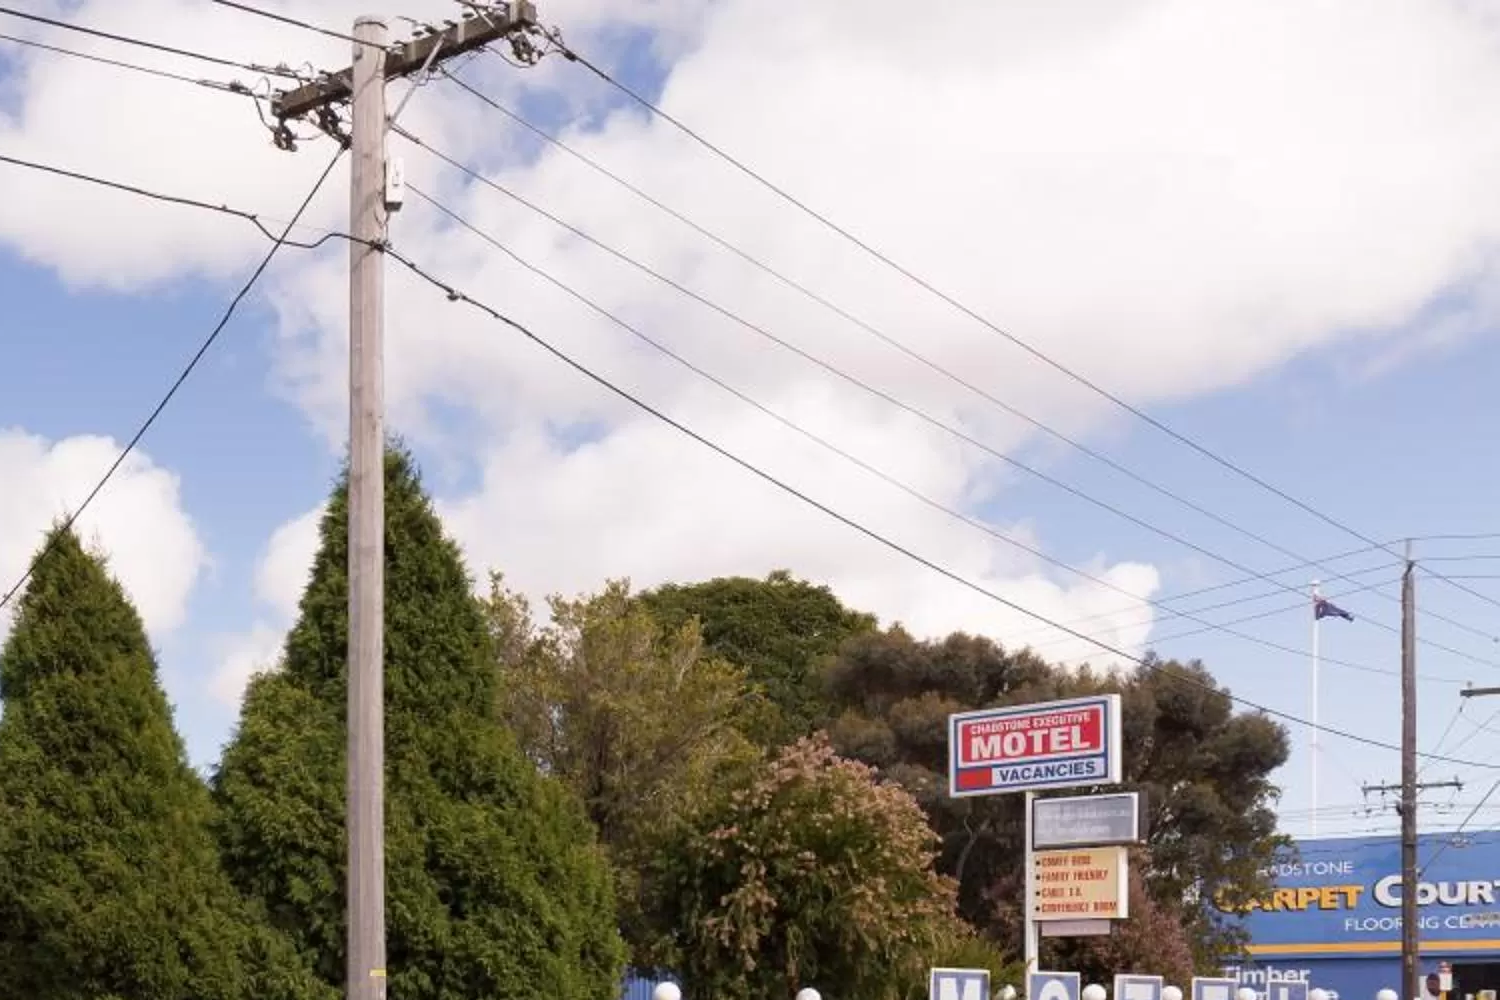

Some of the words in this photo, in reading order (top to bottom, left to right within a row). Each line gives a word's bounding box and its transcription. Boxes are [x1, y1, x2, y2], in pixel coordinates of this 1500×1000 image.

[1033, 712, 1091, 728] EXECUTIVE
[971, 725, 1091, 760] MOTEL
[1000, 761, 1096, 782] VACANCIES
[1374, 873, 1500, 907] COUR
[1344, 916, 1440, 931] FLOORNG
